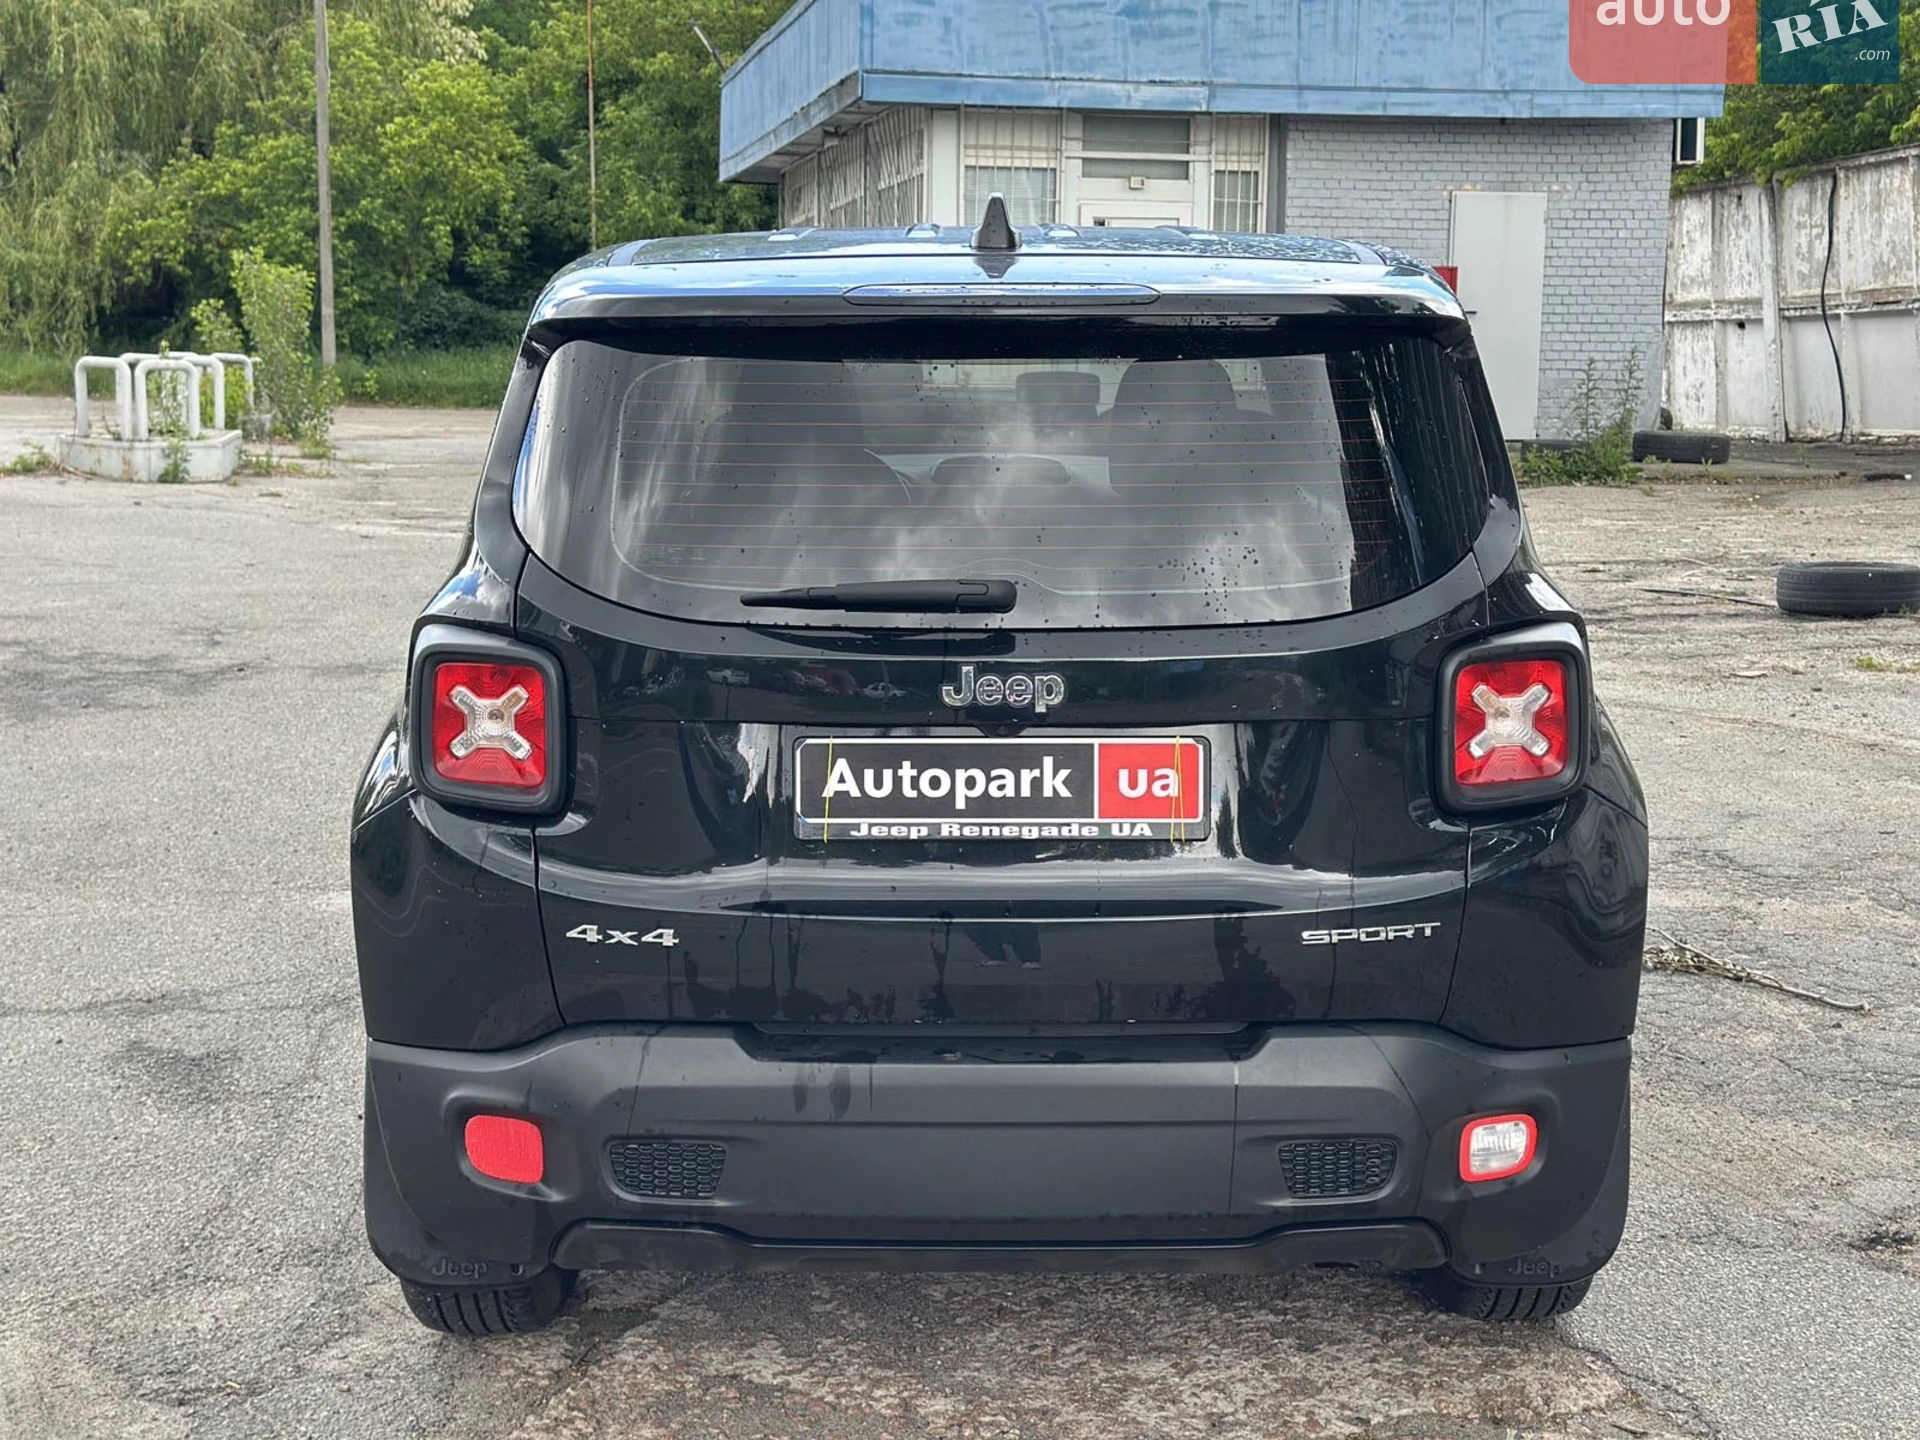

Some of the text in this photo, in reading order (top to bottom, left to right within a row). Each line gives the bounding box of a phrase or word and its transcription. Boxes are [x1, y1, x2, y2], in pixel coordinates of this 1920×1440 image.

[941, 665, 1064, 713] Jeep
[822, 756, 1179, 810] Autopark ua
[850, 823, 1153, 840] Jeep Renegade UA
[566, 924, 680, 947] 4x4
[1301, 922, 1441, 945] SPORT
[432, 1258, 488, 1279] Jeep
[1507, 1258, 1562, 1279] Jeep
